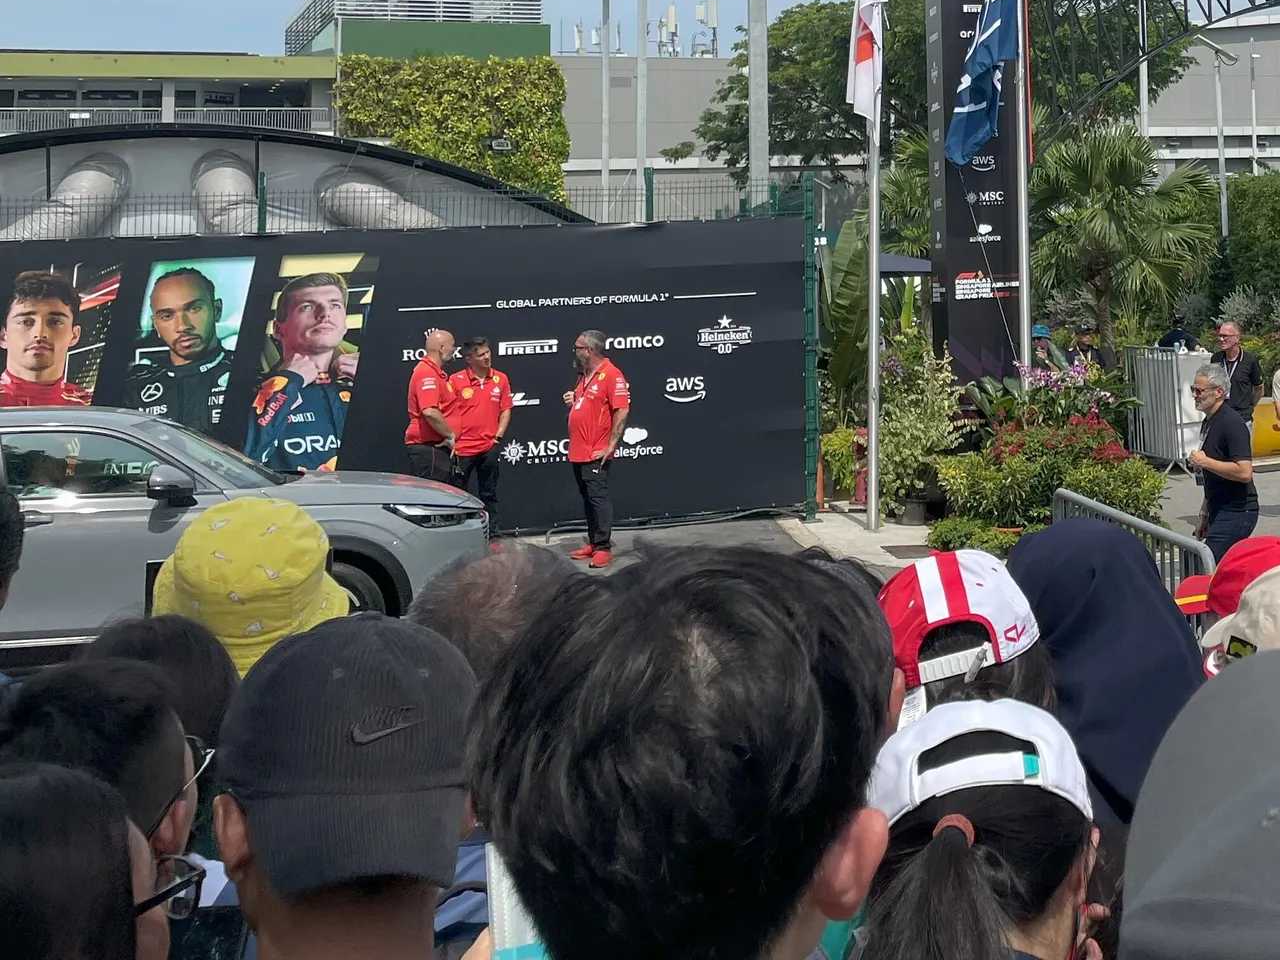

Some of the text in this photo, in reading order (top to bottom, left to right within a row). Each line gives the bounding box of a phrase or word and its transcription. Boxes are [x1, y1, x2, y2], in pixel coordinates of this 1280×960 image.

[972, 155, 995, 165] aws
[979, 191, 1004, 201] MSC
[969, 234, 1001, 244] salesforce
[496, 299, 537, 309] GLOBAL
[538, 296, 592, 307] PARTNERS
[593, 295, 608, 305] OF
[609, 293, 658, 304] FORMULA
[605, 335, 664, 350] ramco
[700, 330, 750, 343] Heineken
[498, 338, 559, 356] PIRELLI
[716, 343, 732, 355] 0.0
[665, 375, 705, 393] aws
[257, 392, 288, 427] Red Bull
[284, 434, 341, 455] ORA
[527, 438, 570, 457] MSC
[614, 444, 663, 460] alesforce
[526, 455, 568, 465] CRUISE
